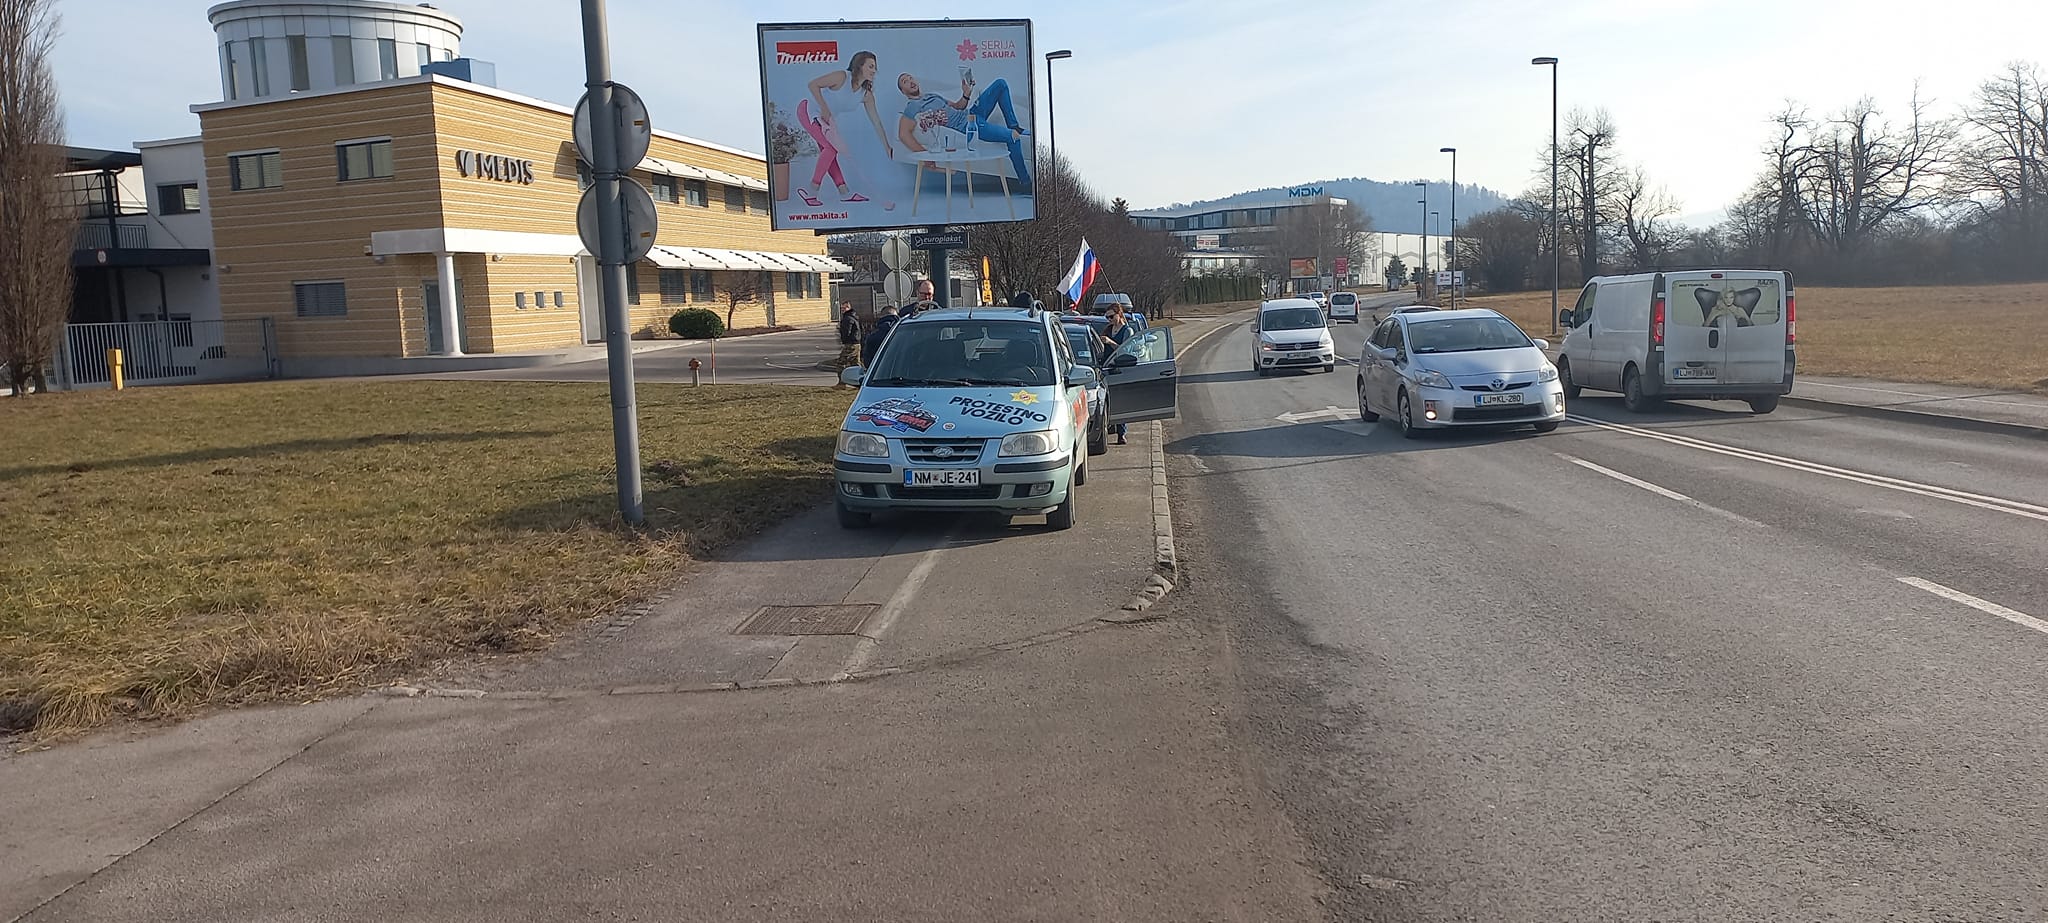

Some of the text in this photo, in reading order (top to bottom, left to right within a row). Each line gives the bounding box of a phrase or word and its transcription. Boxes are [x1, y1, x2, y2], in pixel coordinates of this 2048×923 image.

[981, 40, 1015, 50] SERIJA
[777, 51, 836, 64] makita
[981, 50, 1016, 59] SAKURA
[476, 153, 535, 185] MEDIS
[1288, 186, 1324, 198] MDM
[788, 211, 848, 221] www.makita.si
[923, 234, 962, 244] europlakat
[1482, 395, 1492, 404] LJ
[949, 396, 1048, 423] PROTESTNO
[961, 407, 1023, 425] VOZILO
[914, 471, 977, 484] NM JE-241
